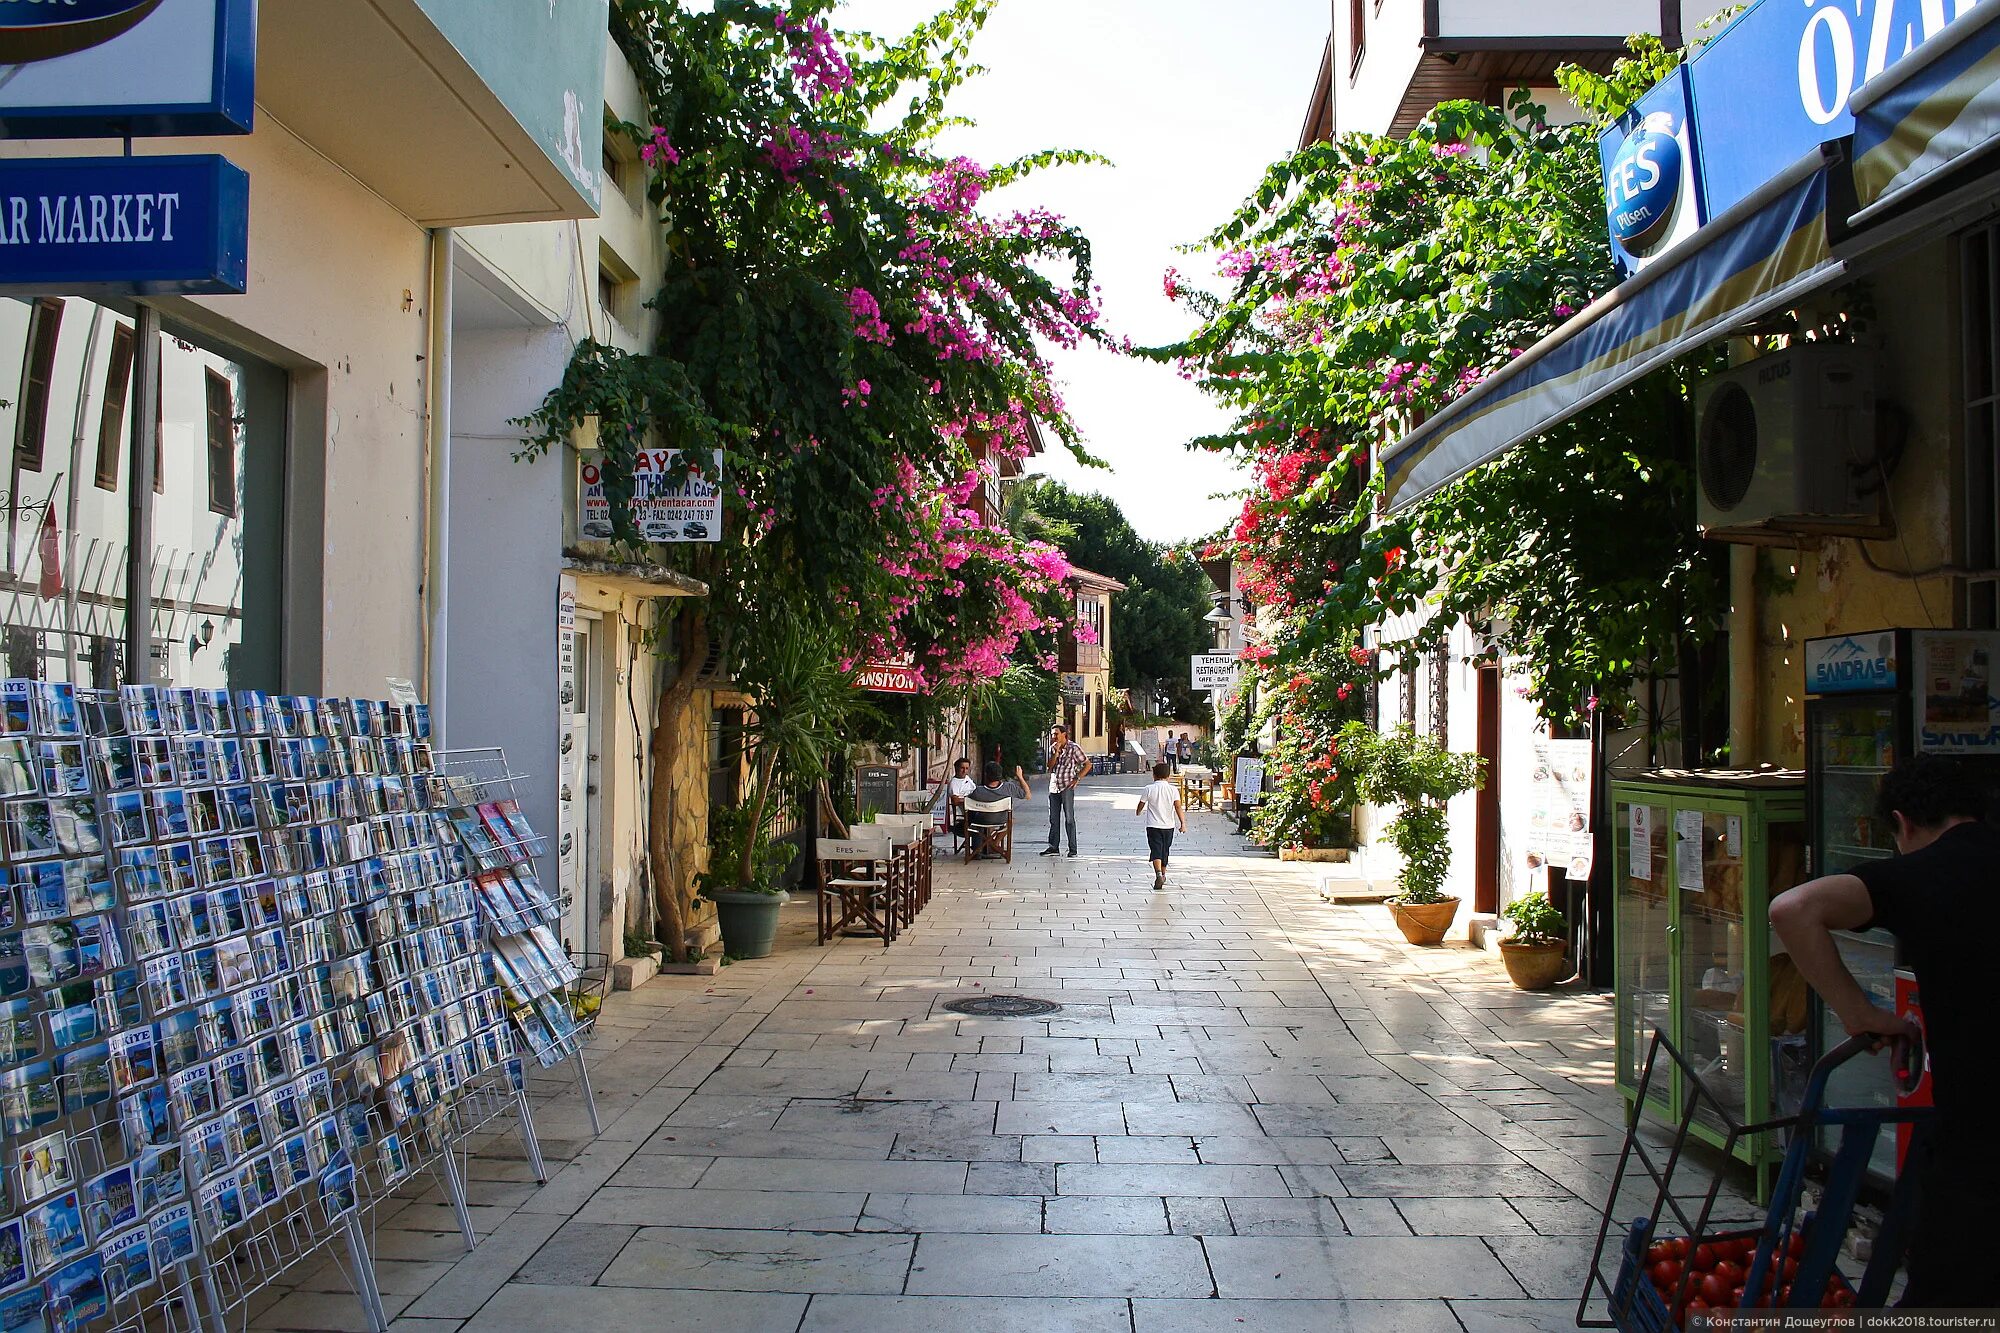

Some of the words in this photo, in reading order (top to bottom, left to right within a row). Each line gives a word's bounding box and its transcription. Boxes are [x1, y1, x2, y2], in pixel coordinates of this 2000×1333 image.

[38, 193, 179, 244] MARKET
[1616, 206, 1652, 231] Pilsen
[586, 510, 599, 520] TEL:
[653, 510, 666, 520] FAX:
[667, 510, 682, 520] 0242
[684, 510, 695, 520] 247
[697, 510, 705, 520] 76
[706, 510, 714, 520] 97
[561, 643, 572, 652] CARS
[562, 654, 571, 662] AND
[561, 665, 573, 674] PRICE
[1195, 666, 1235, 675] RESTAURANT
[1816, 657, 1887, 684] SANDRAS
[835, 846, 854, 854] EFES
